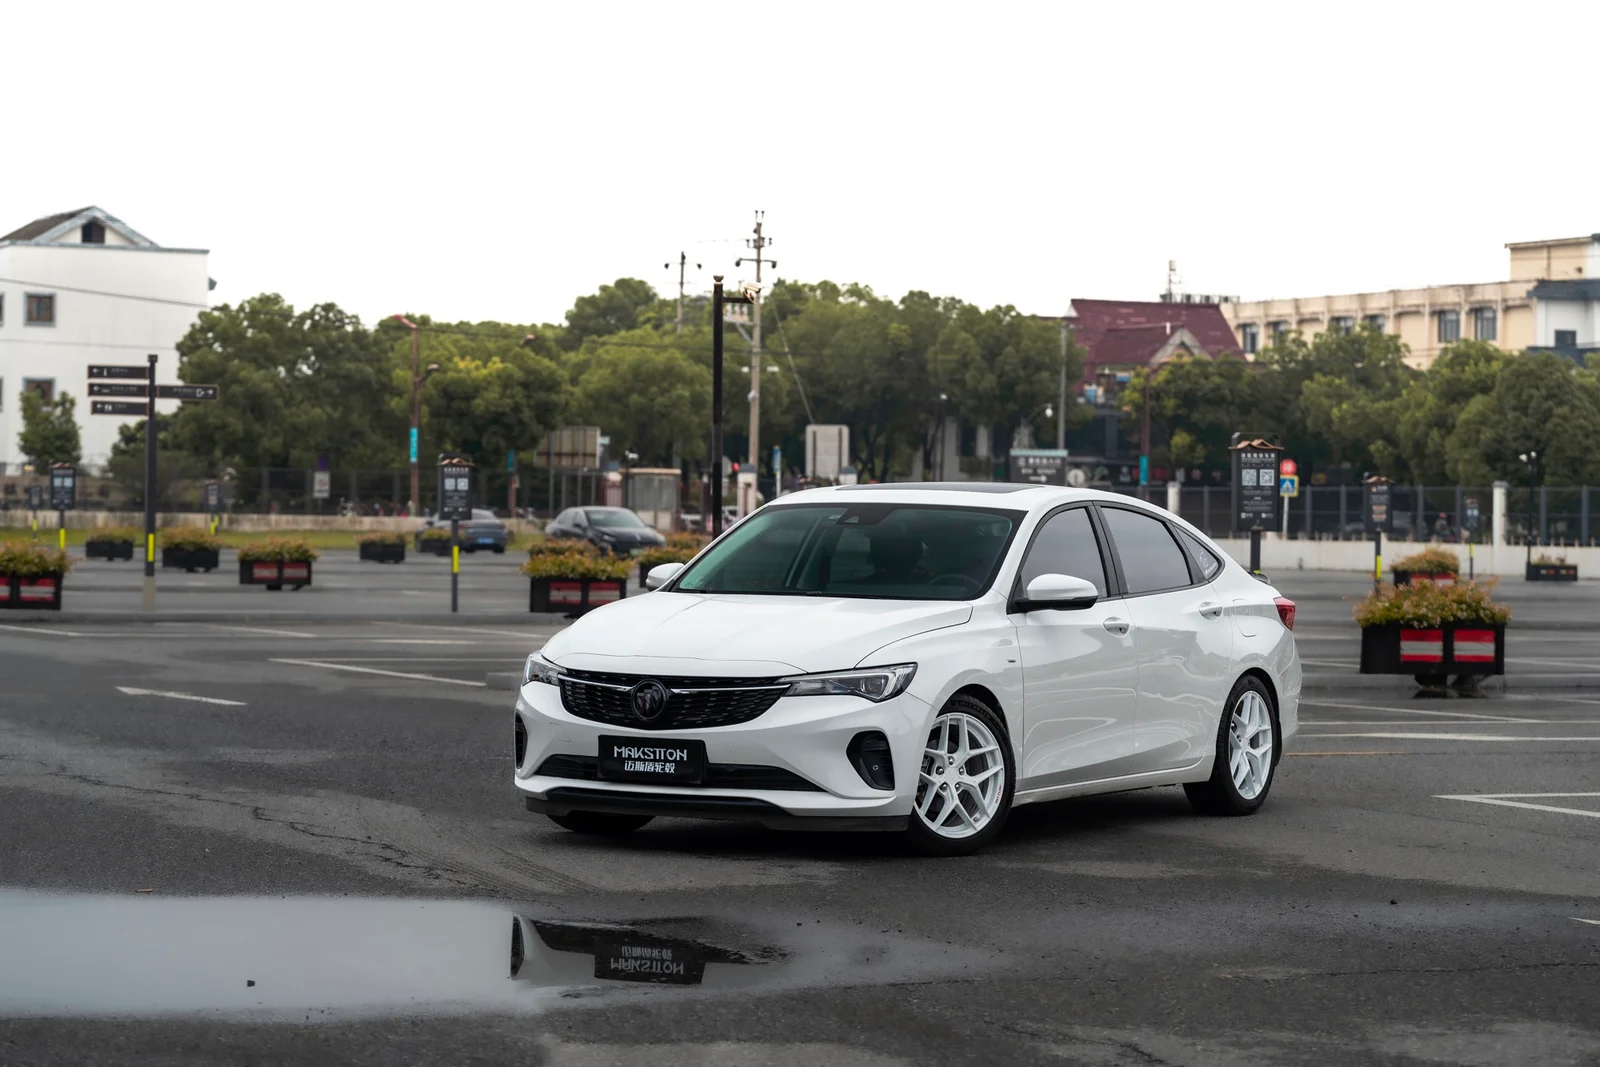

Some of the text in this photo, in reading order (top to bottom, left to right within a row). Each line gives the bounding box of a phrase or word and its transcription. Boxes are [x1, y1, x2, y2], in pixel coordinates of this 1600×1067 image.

[960, 701, 991, 719] MICHELIN
[624, 760, 675, 773] 迈斯盾轮毂
